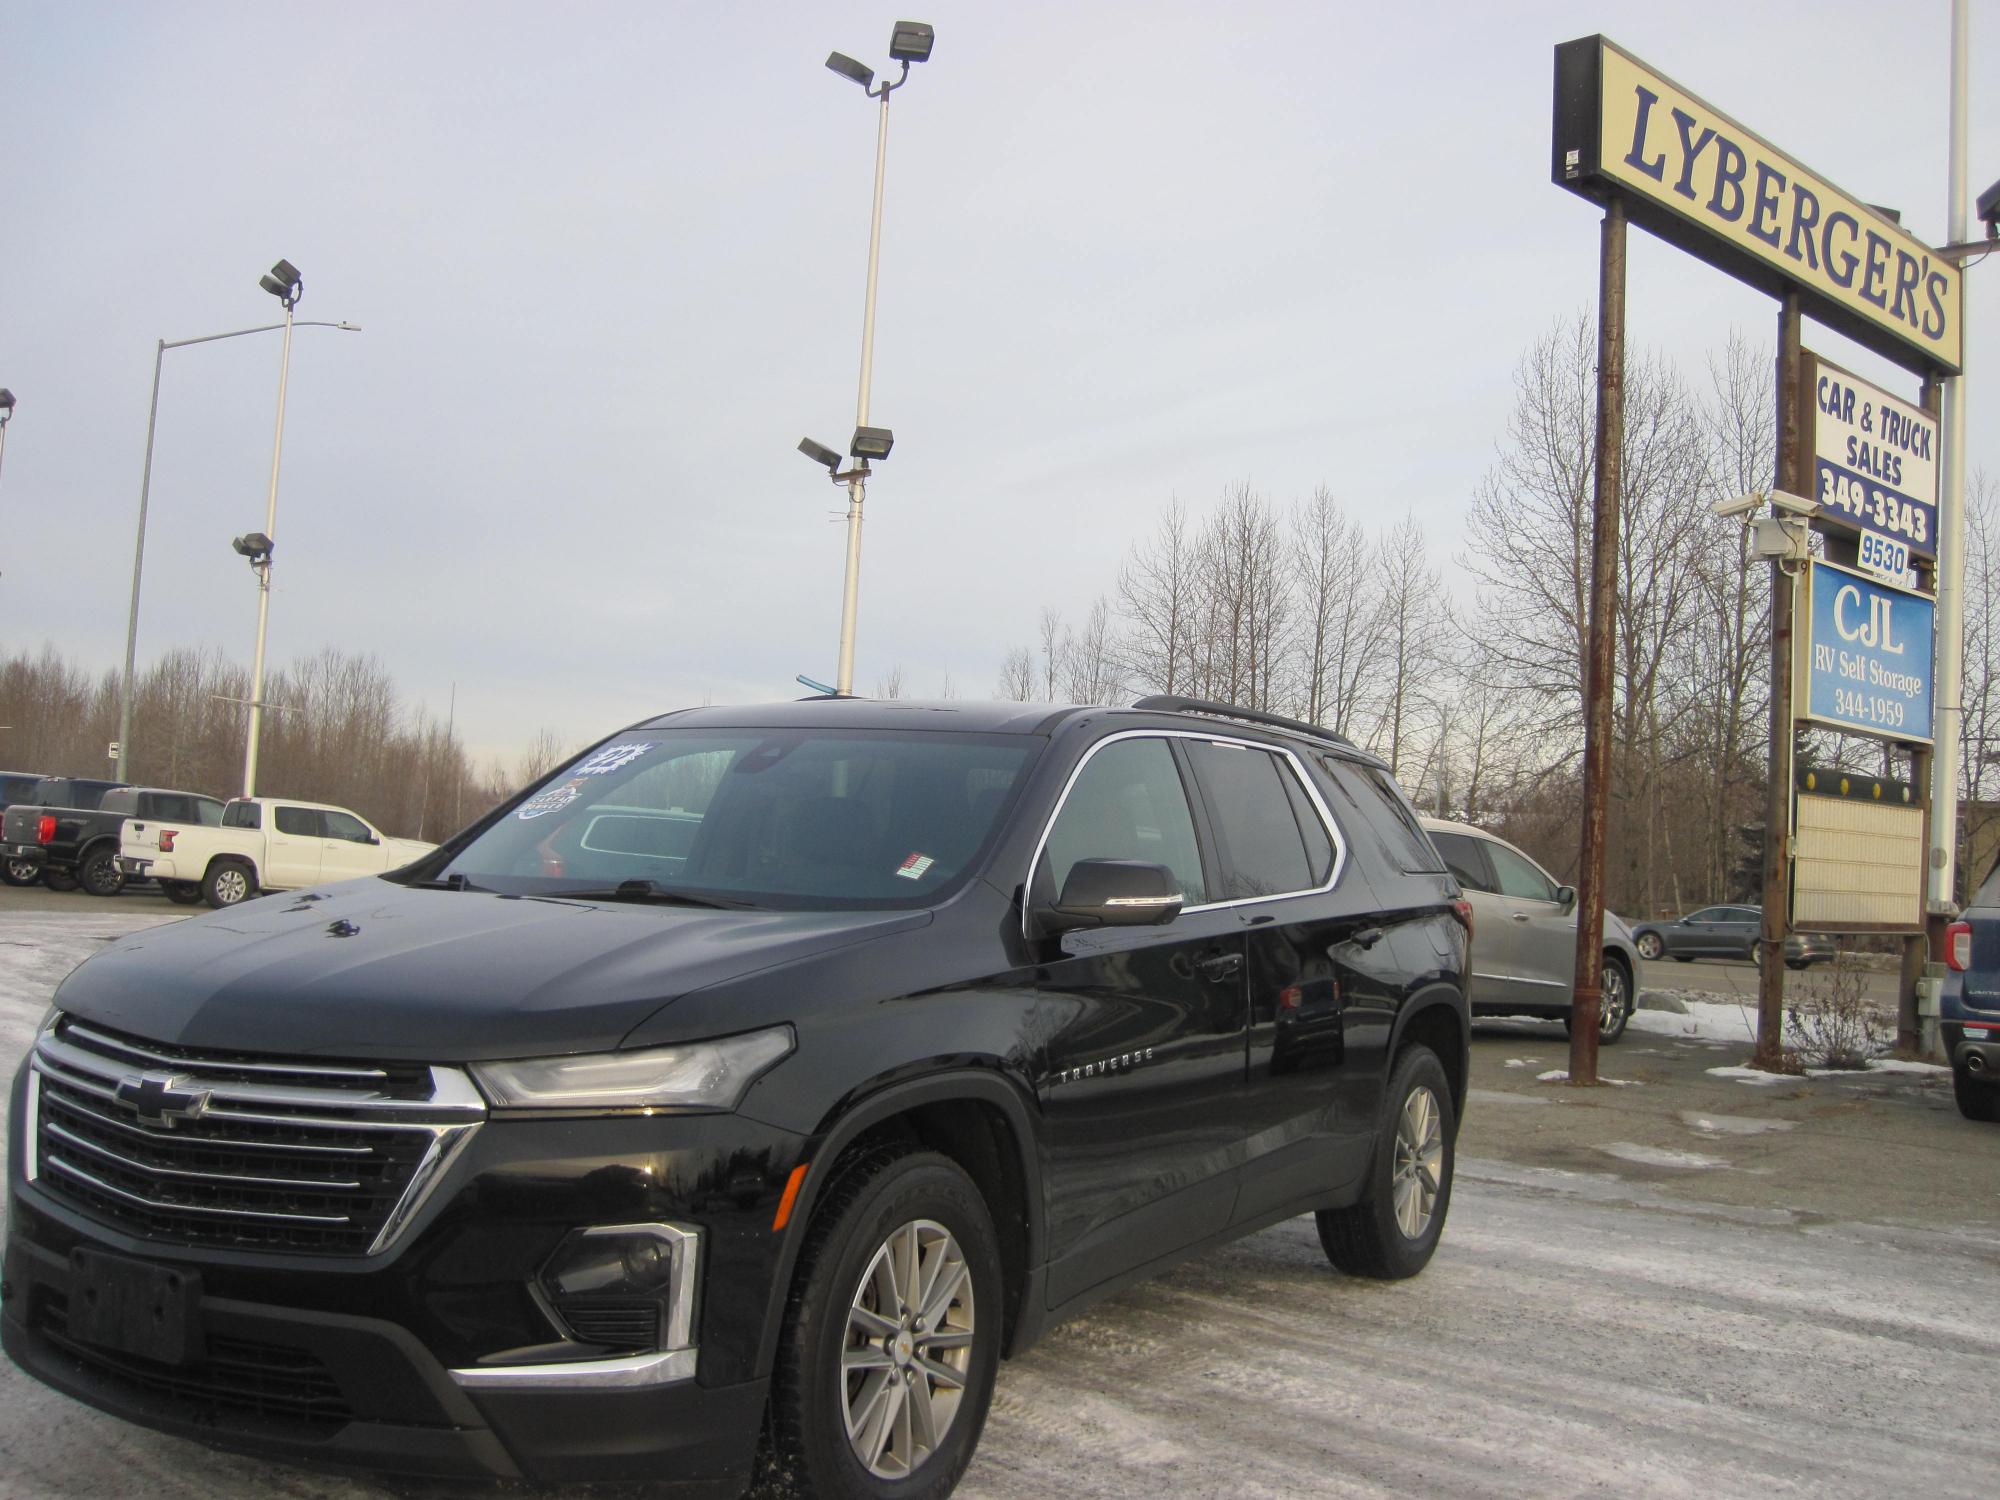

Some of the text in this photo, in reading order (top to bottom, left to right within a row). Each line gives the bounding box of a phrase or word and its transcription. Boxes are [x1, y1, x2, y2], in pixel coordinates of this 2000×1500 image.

[1624, 85, 1948, 341] LYBERGER'S
[1818, 376, 1931, 462] CAR & TRUCK
[1846, 435, 1901, 486] SALES
[1821, 468, 1926, 543] 349-3343
[1861, 535, 1905, 575] 9530
[1834, 585, 1904, 654] CJL
[1815, 644, 1922, 698] RV Self Storage
[1835, 689, 1904, 727] 344-1959
[1061, 1048, 1153, 1083] TRAVERSE
